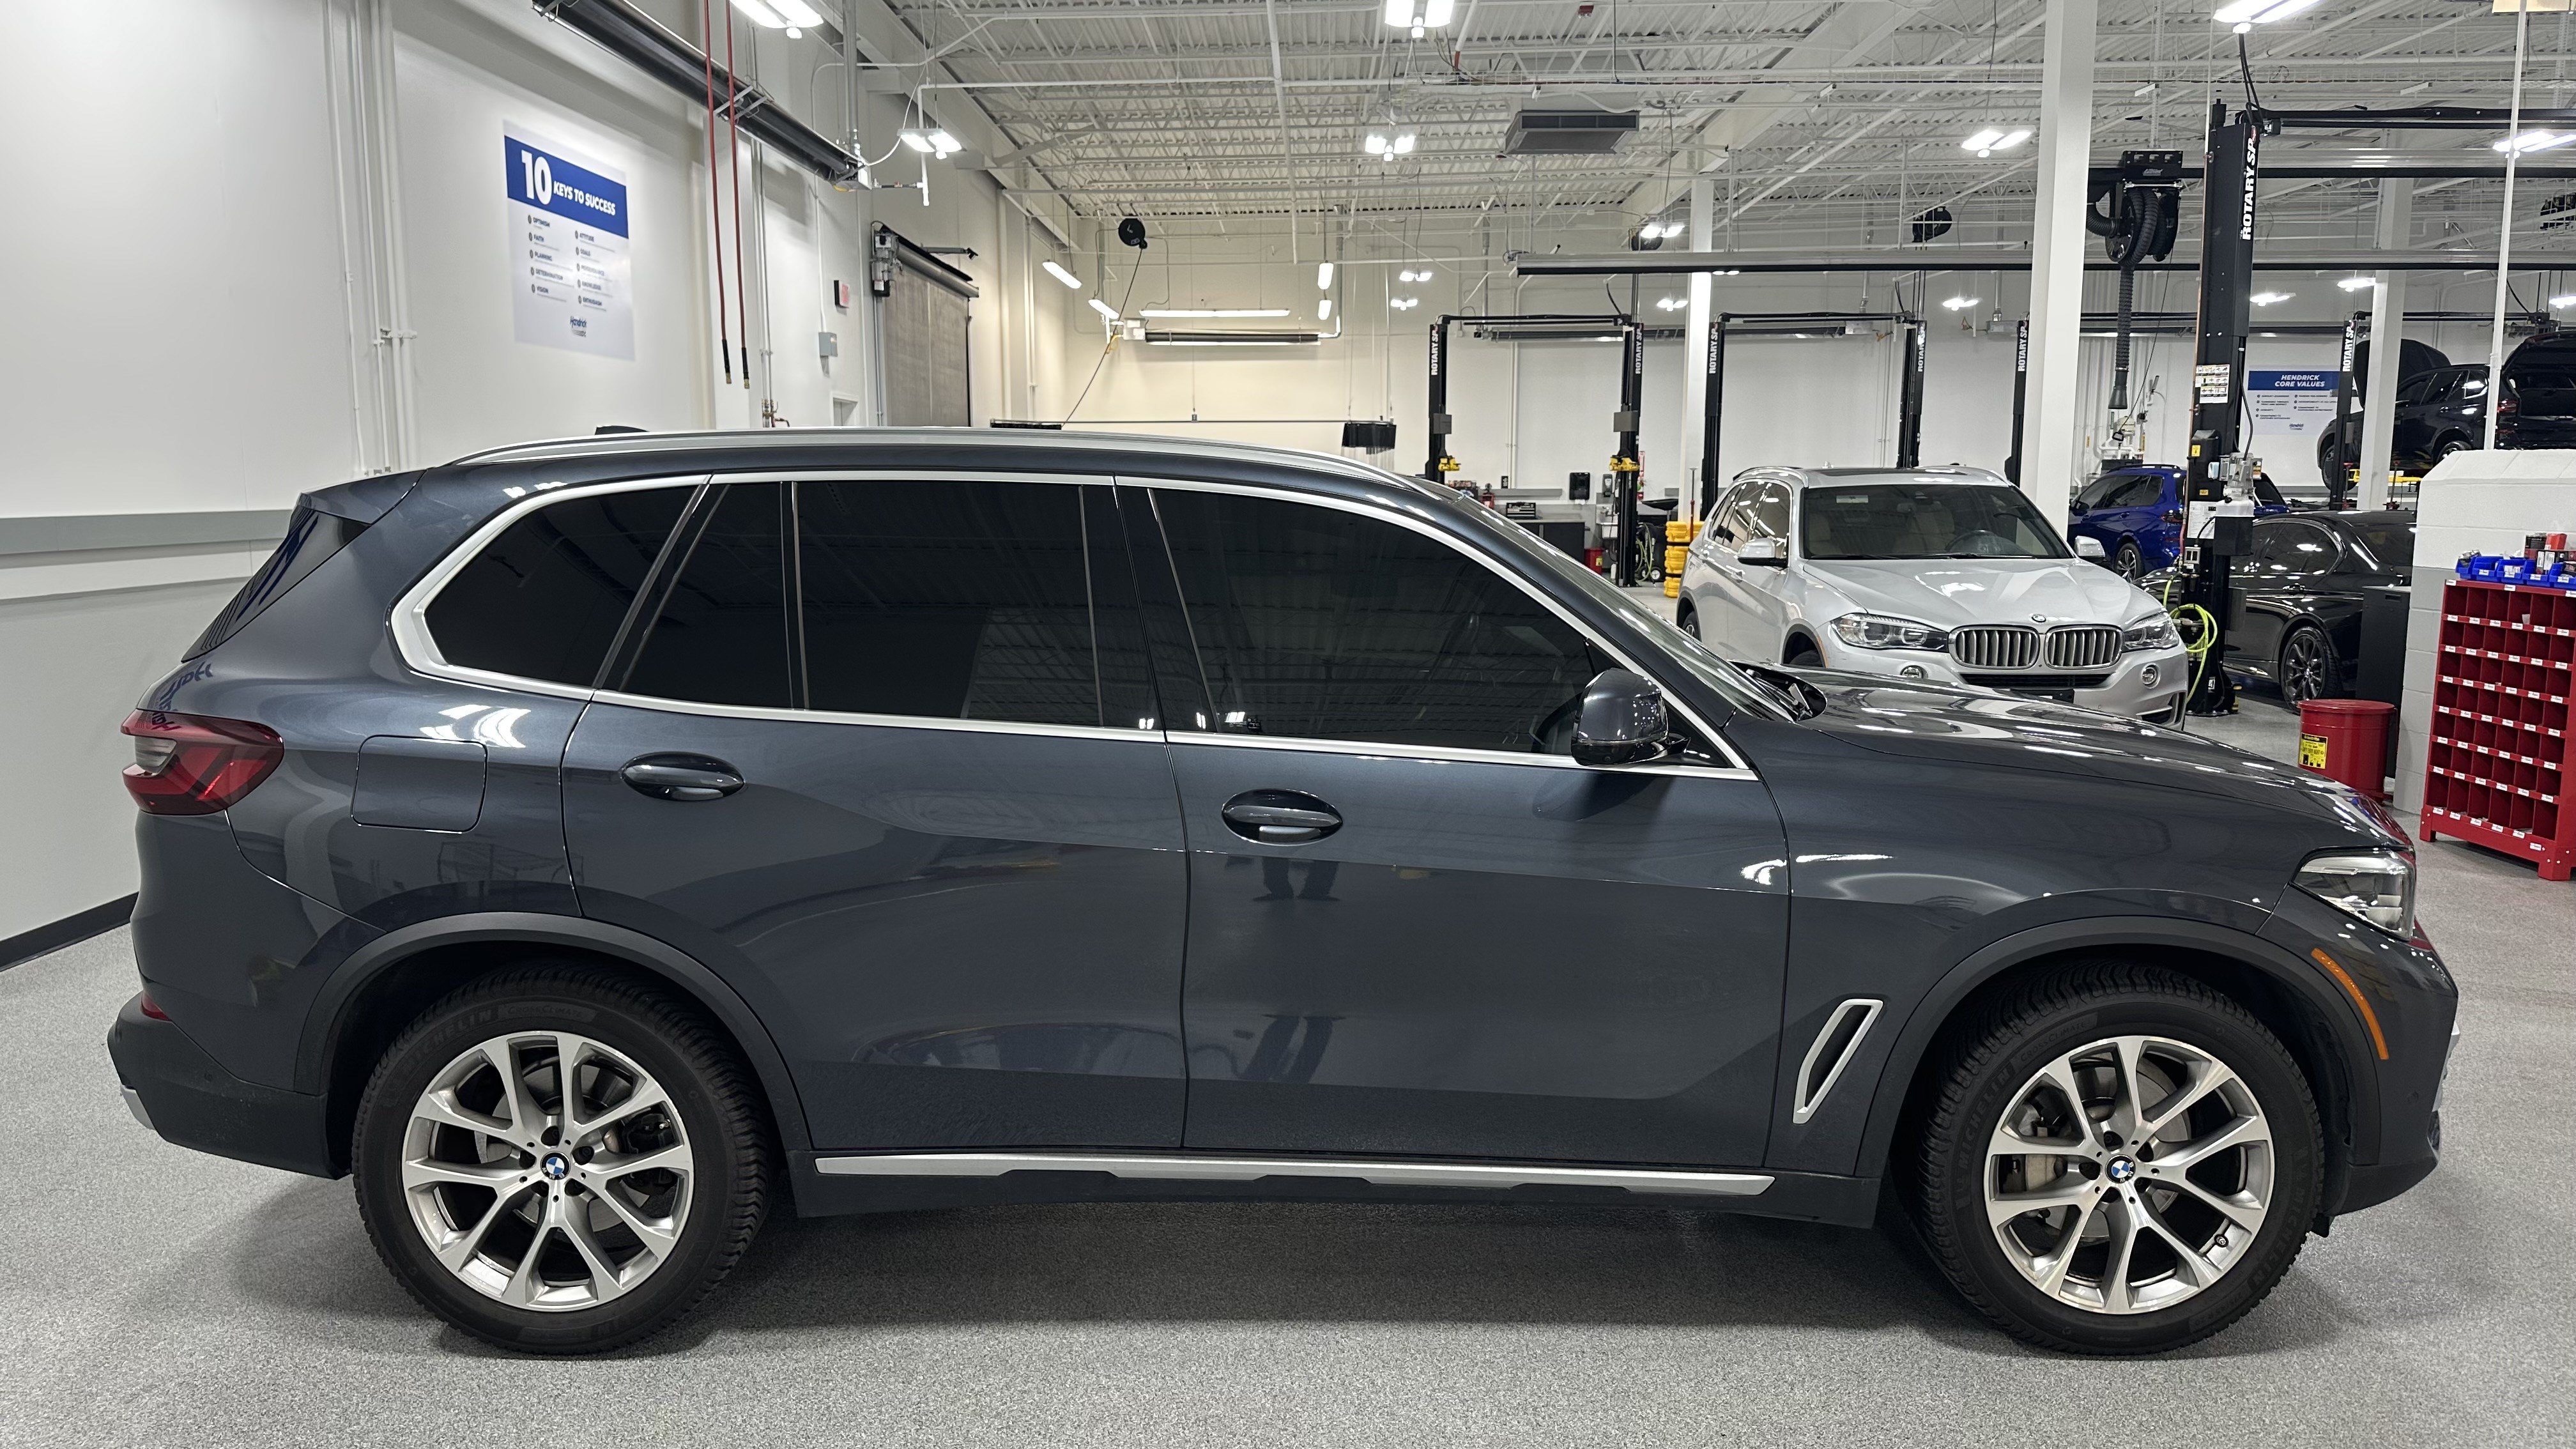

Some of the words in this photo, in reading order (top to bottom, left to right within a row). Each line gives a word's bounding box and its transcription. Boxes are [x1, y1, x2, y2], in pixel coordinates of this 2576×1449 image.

[521, 150, 552, 205] 10
[553, 180, 573, 200] KEYS
[574, 189, 585, 204] TO
[585, 193, 616, 216] SUCCESS
[2242, 165, 2255, 240] ROTARY
[1708, 341, 1718, 374] ROTARY
[2018, 339, 2027, 372] ROTARY
[2342, 338, 2353, 372] ROTARY
